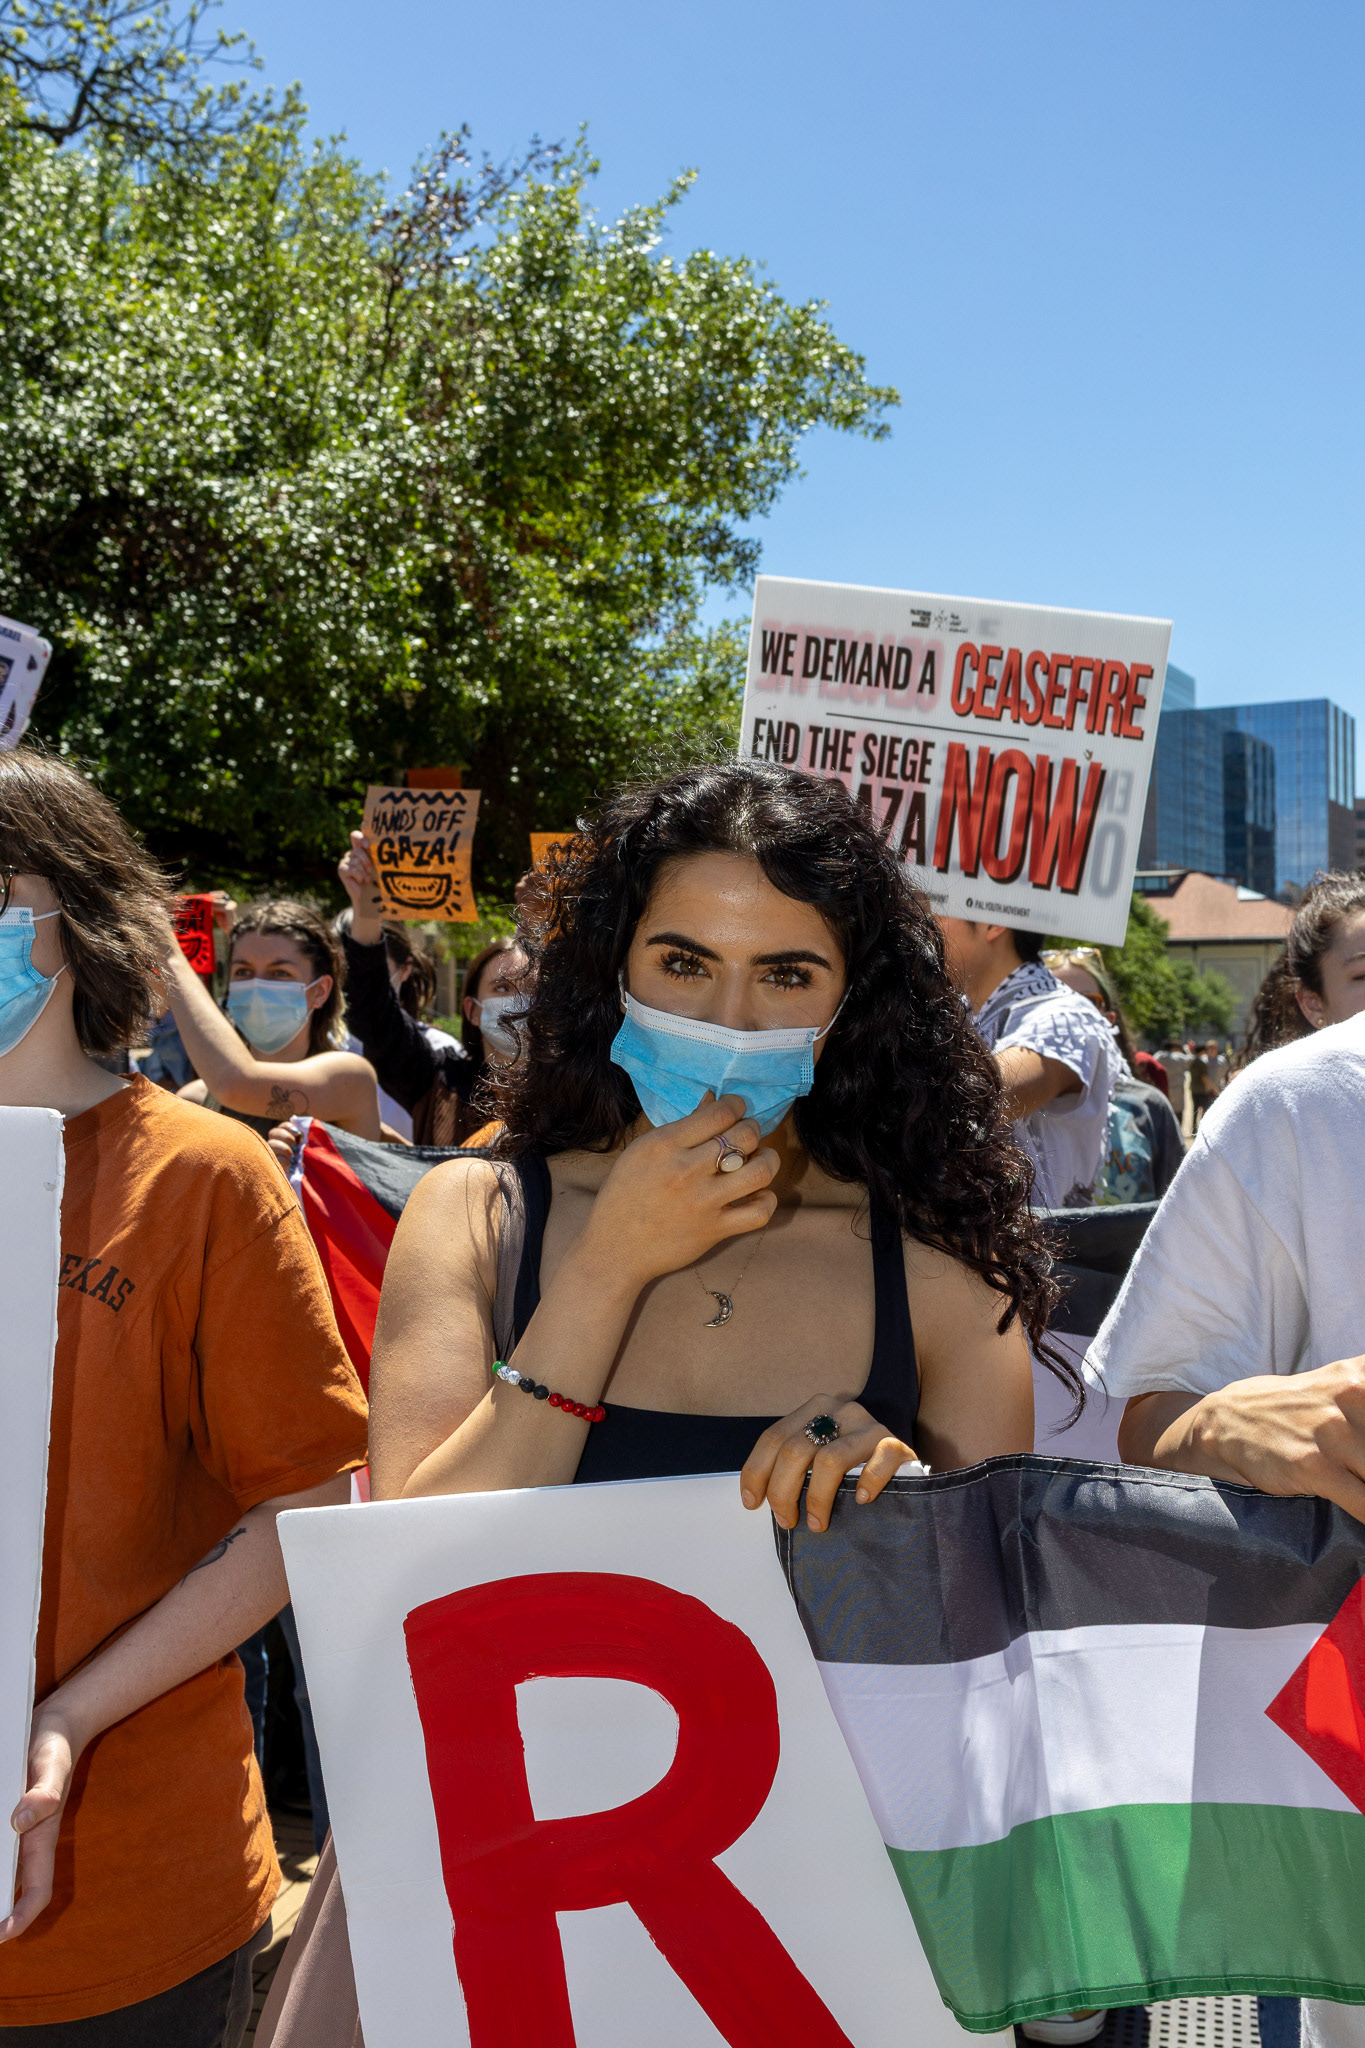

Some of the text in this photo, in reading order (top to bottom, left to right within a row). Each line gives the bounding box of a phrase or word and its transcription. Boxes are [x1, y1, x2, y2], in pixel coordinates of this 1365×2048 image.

[761, 630, 1154, 741] WE DEMAND A CEASEFIRE
[752, 717, 936, 784] END THE SIEGE
[372, 806, 467, 836] HANDS OFF
[377, 831, 460, 868] GAZA!
[933, 741, 1107, 895] NOW
[58, 1252, 136, 1313] EXAS
[403, 1571, 857, 2048] R
